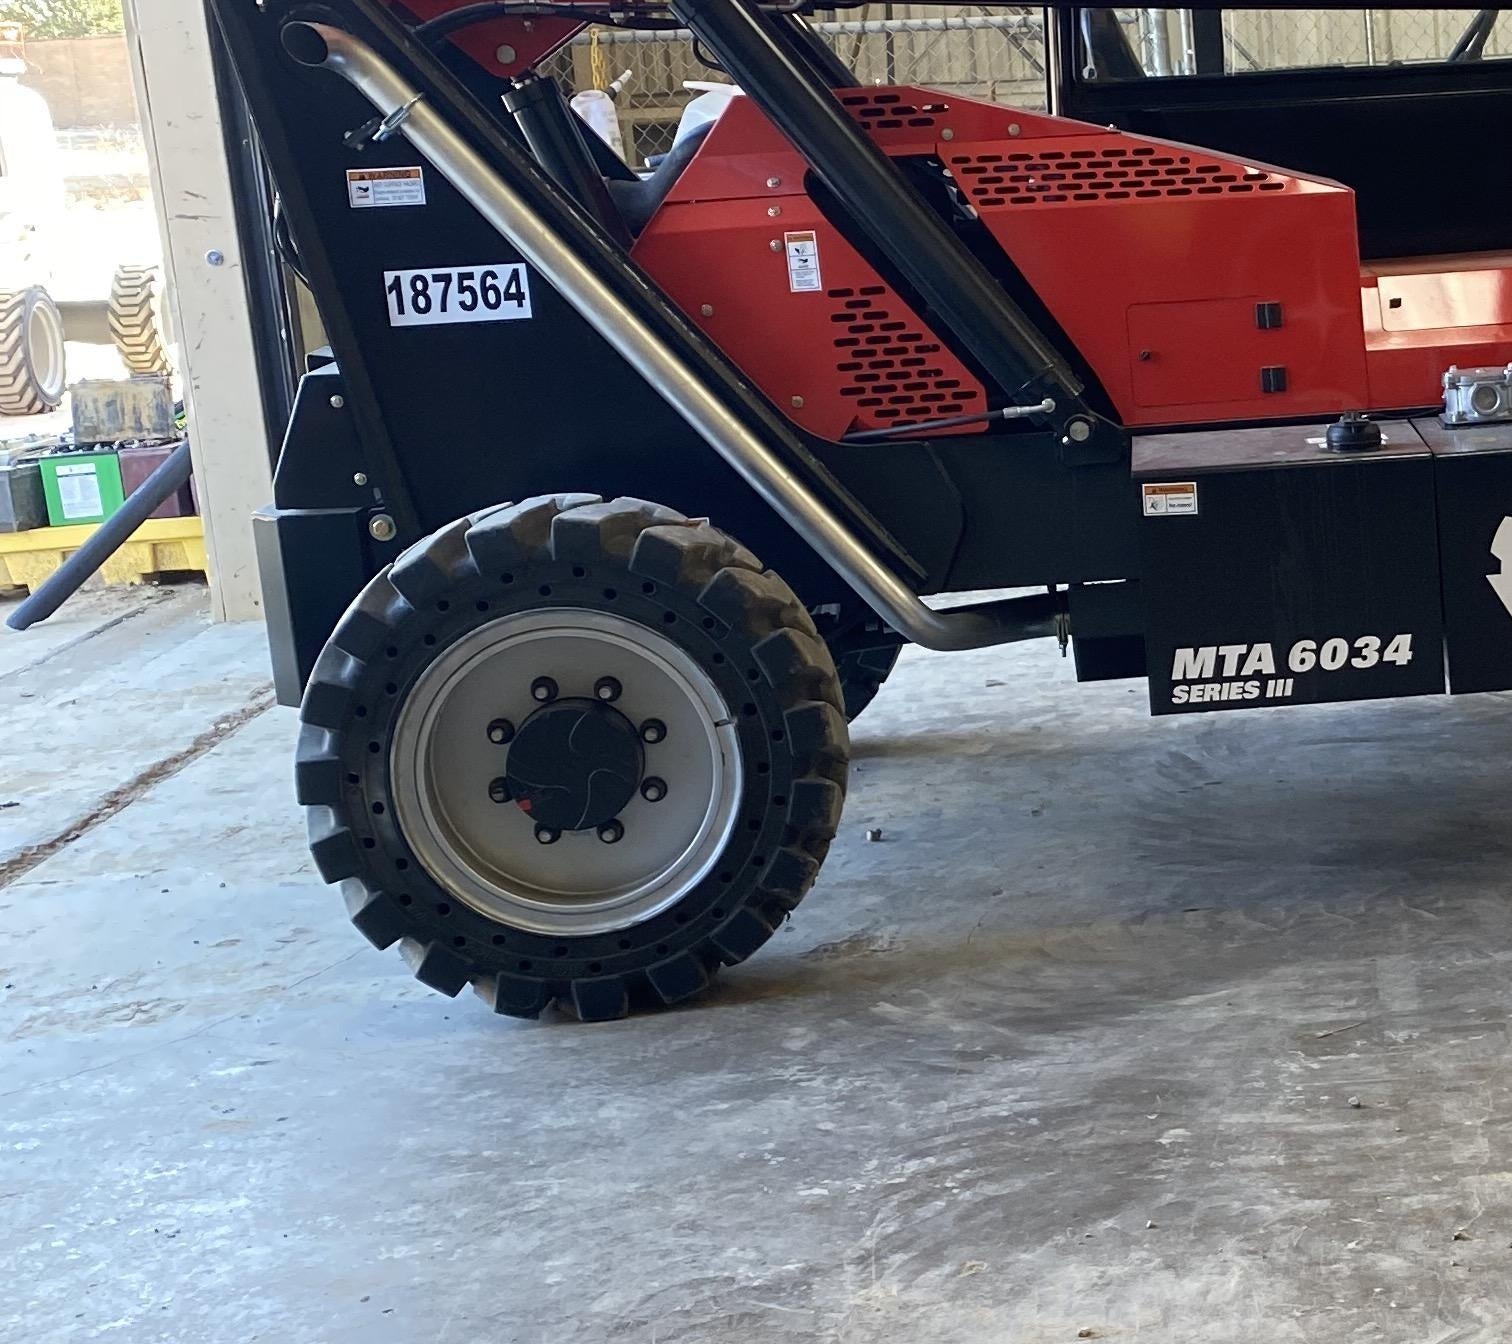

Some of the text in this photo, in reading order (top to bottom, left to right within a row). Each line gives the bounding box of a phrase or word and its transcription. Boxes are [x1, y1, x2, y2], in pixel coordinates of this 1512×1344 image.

[387, 267, 526, 316] 187564
[1171, 633, 1413, 681] MTA 6034
[1171, 678, 1294, 705] SERIES III
